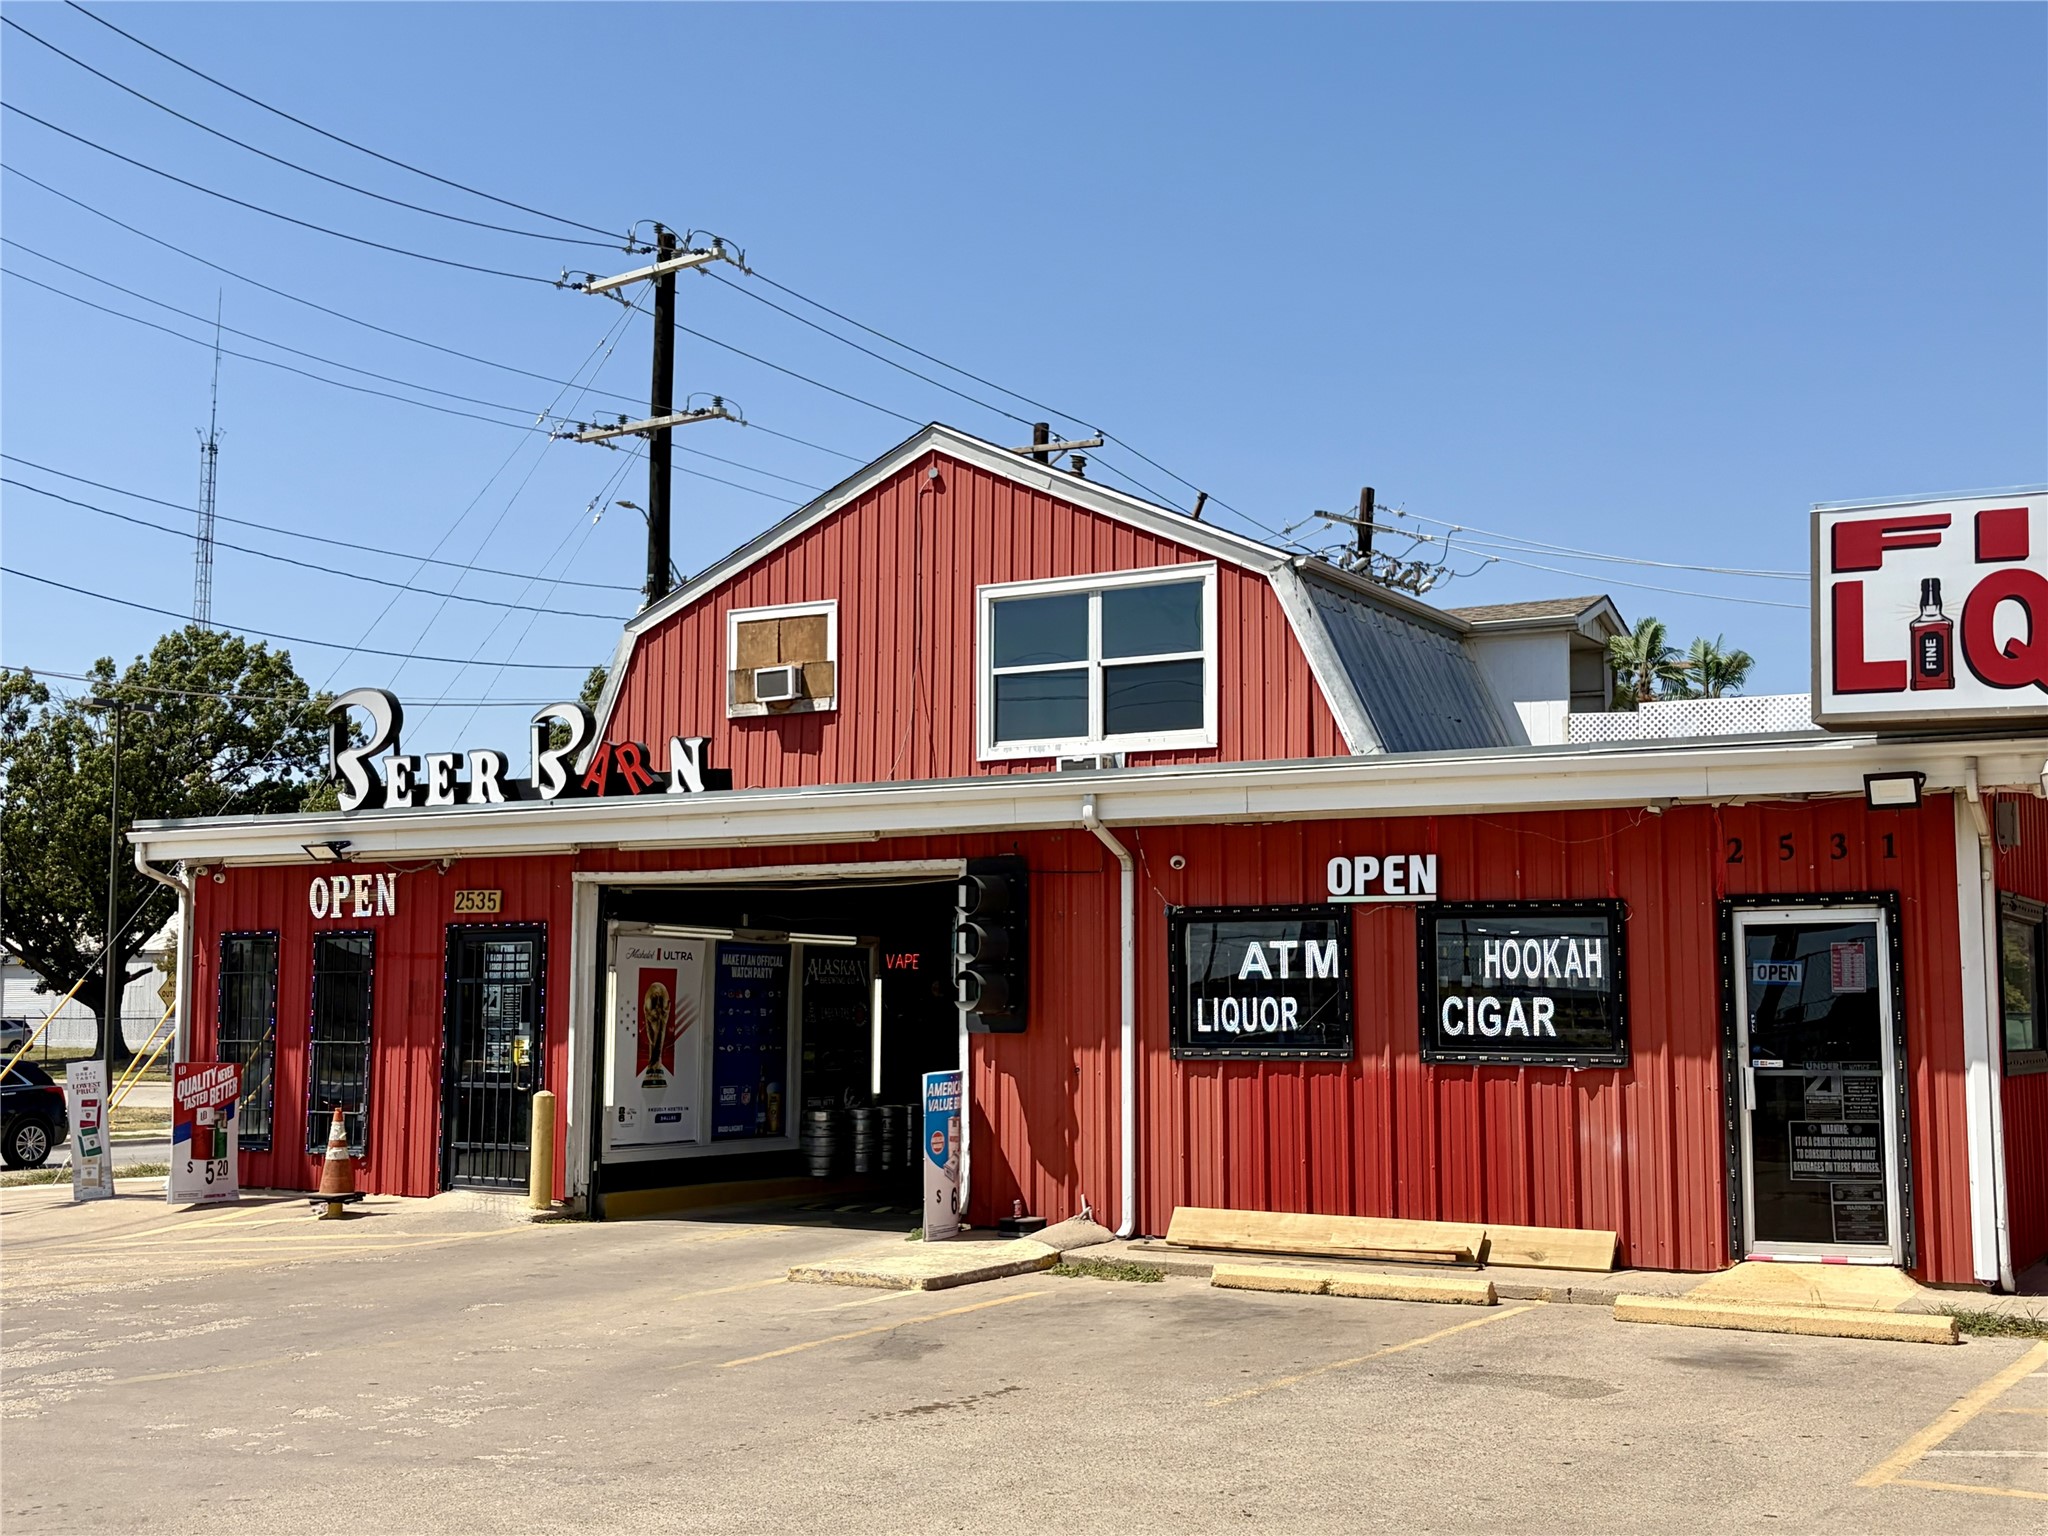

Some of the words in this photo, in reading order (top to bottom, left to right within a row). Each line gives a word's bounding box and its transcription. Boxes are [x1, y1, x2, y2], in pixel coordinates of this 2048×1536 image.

[1926, 638, 1936, 670] FINE
[1327, 854, 1437, 895] OPEN
[309, 873, 396, 919] OPEN
[455, 891, 498, 911] 2535
[663, 951, 693, 960] ULTRA
[886, 954, 919, 969] VAPE
[1238, 939, 1339, 980] ATM
[1484, 938, 1602, 979] HOOKAH
[731, 966, 752, 978] WATCH
[753, 967, 773, 979] PARTY
[1757, 965, 1797, 981] OPEN
[1197, 997, 1299, 1034] LIQUOR
[1442, 996, 1557, 1037] CIGAR
[1805, 1062, 1839, 1070] UNDER
[177, 1065, 218, 1102] QUALITY
[217, 1064, 234, 1084] NEVER
[183, 1090, 208, 1111] TASTED
[209, 1076, 238, 1106] BETTER
[928, 1097, 954, 1112] VALUE
[1795, 1136, 1801, 1146] IT
[1801, 1136, 1807, 1146] IS
[1808, 1137, 1812, 1146] A
[1813, 1136, 1831, 1147] CRIME
[1796, 1149, 1803, 1159] TO
[1853, 1149, 1861, 1160] OR
[187, 1161, 194, 1174] $
[936, 1189, 942, 1204] $
[951, 1187, 958, 1215] 6
